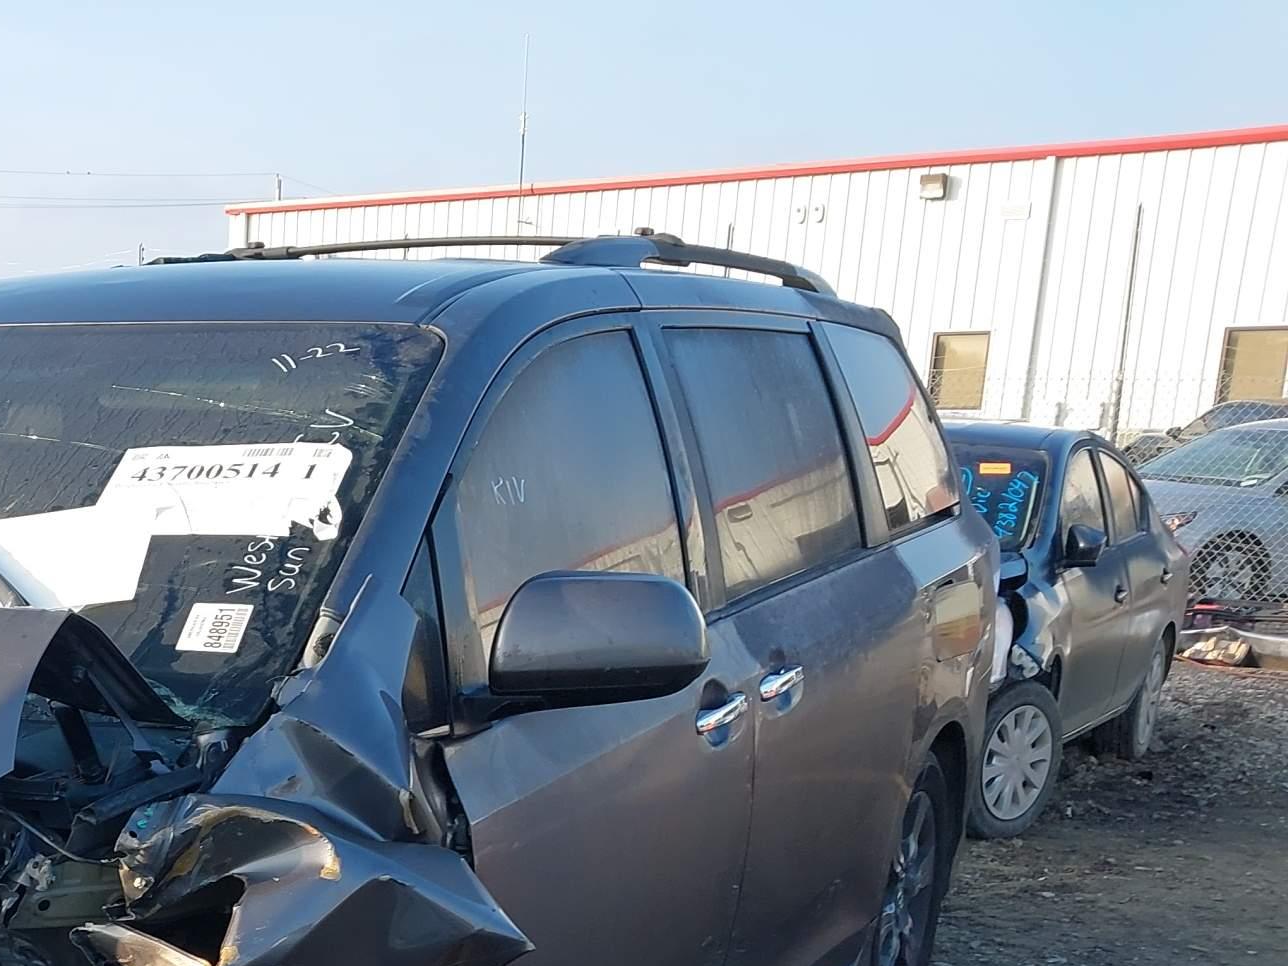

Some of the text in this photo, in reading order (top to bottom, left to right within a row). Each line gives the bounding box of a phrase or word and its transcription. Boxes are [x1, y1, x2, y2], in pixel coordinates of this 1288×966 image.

[271, 342, 361, 373] 11-22
[130, 461, 282, 482] 43700514
[267, 547, 310, 592] Sun
[203, 607, 236, 649] 848951
